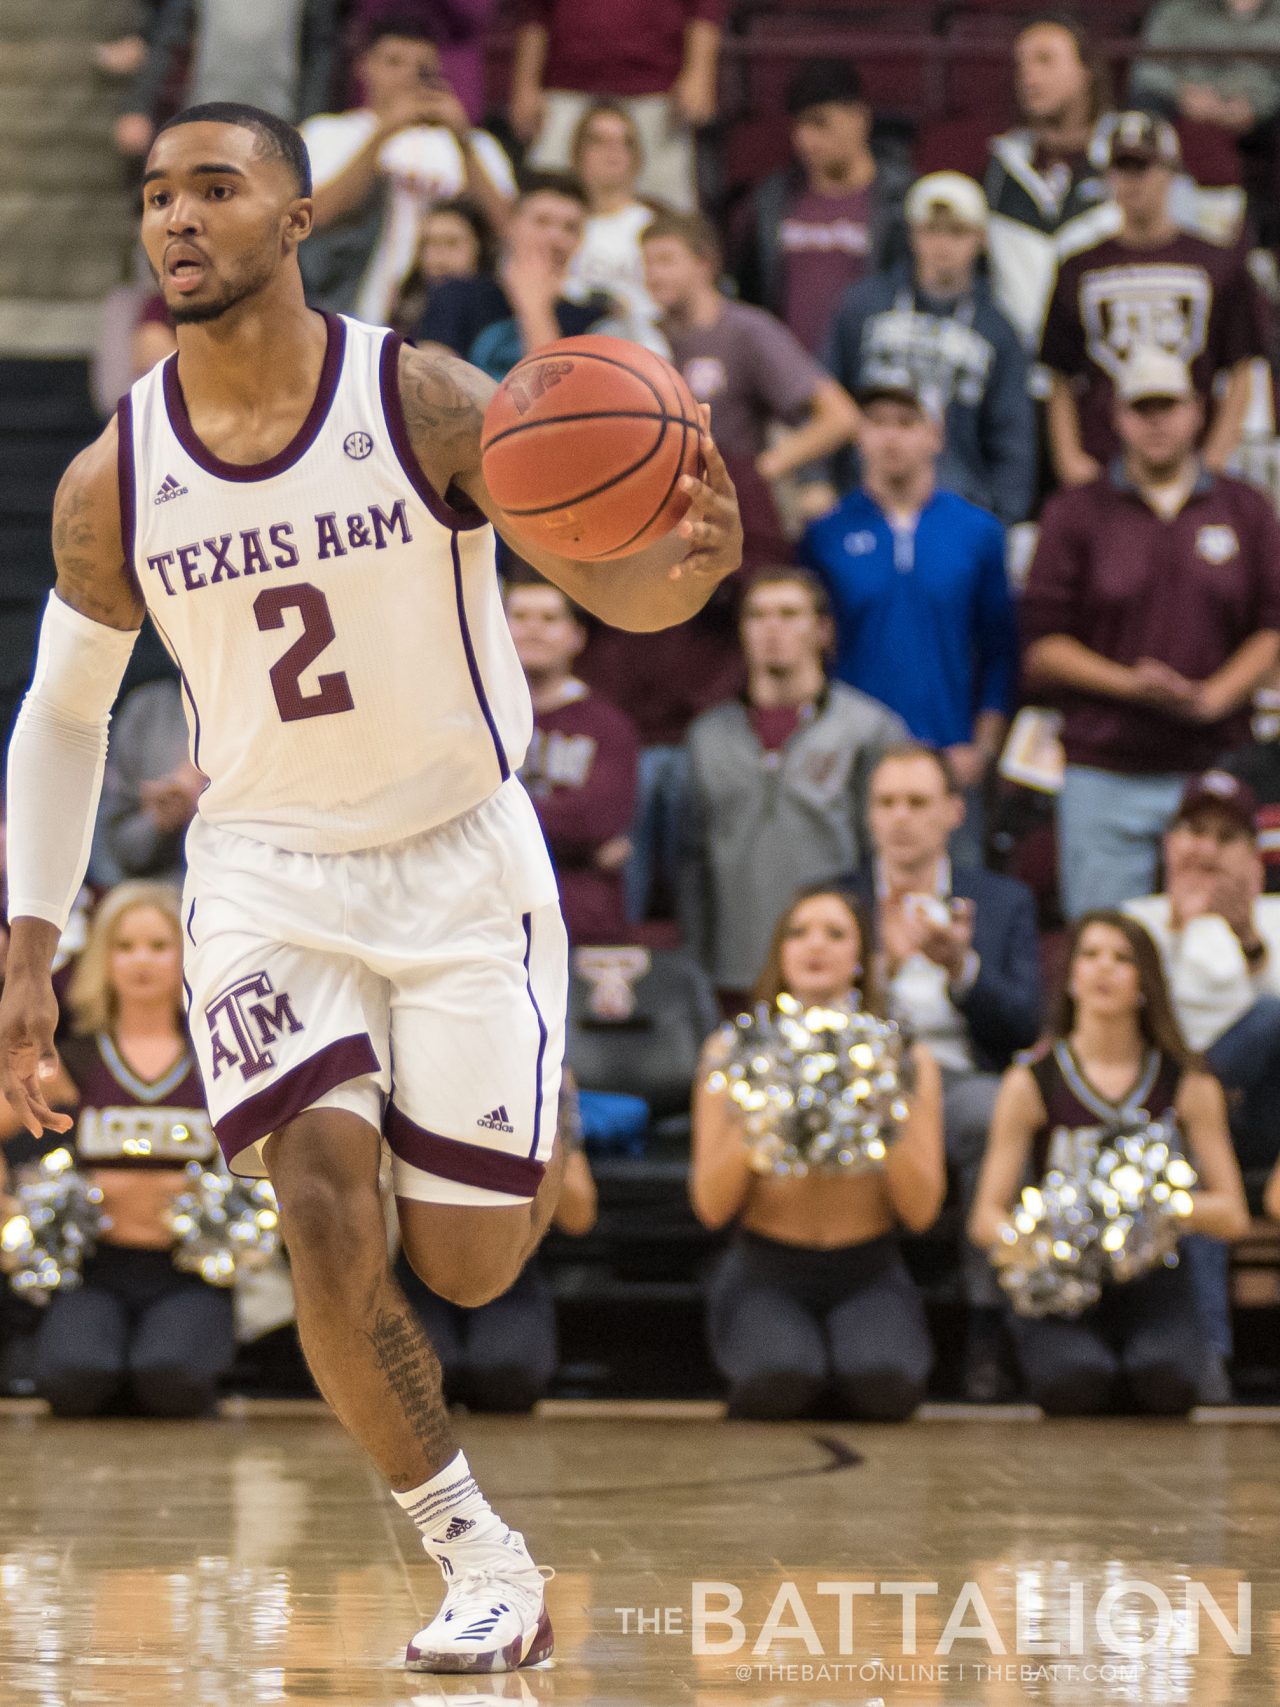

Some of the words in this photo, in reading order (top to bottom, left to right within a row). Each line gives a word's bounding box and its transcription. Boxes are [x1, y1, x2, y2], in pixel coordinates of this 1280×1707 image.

[343, 431, 373, 460] SEC
[153, 486, 189, 505] adidas
[147, 520, 300, 596] TEXAS
[314, 498, 414, 560] A&M
[253, 582, 355, 722] 2
[476, 1118, 514, 1133] adidas
[445, 1518, 477, 1540] adidas
